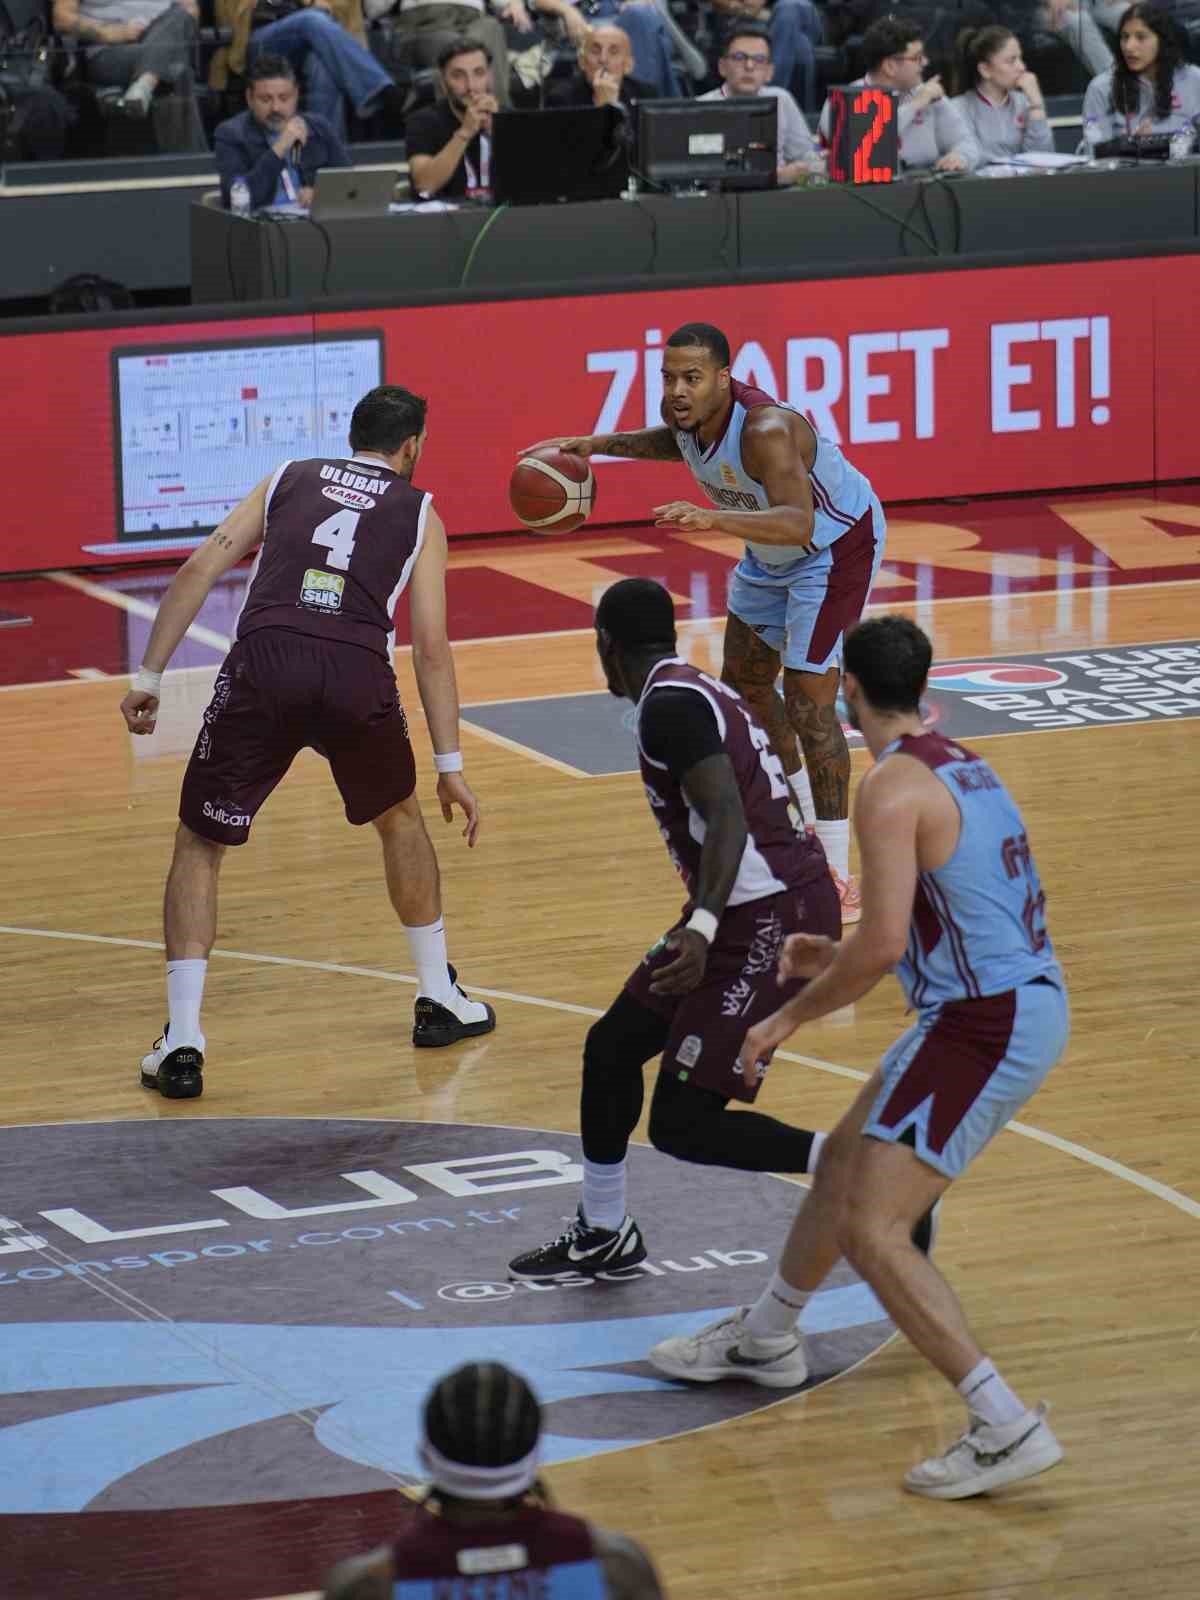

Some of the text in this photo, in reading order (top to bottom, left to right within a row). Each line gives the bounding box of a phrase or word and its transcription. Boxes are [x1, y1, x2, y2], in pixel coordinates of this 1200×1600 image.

[853, 88, 893, 184] 2
[586, 316, 1111, 463] ZİARET ET!
[320, 464, 392, 495] ULUBAY
[312, 508, 361, 571] 4
[203, 801, 250, 827] Sultan
[742, 911, 775, 976] ROYAL
